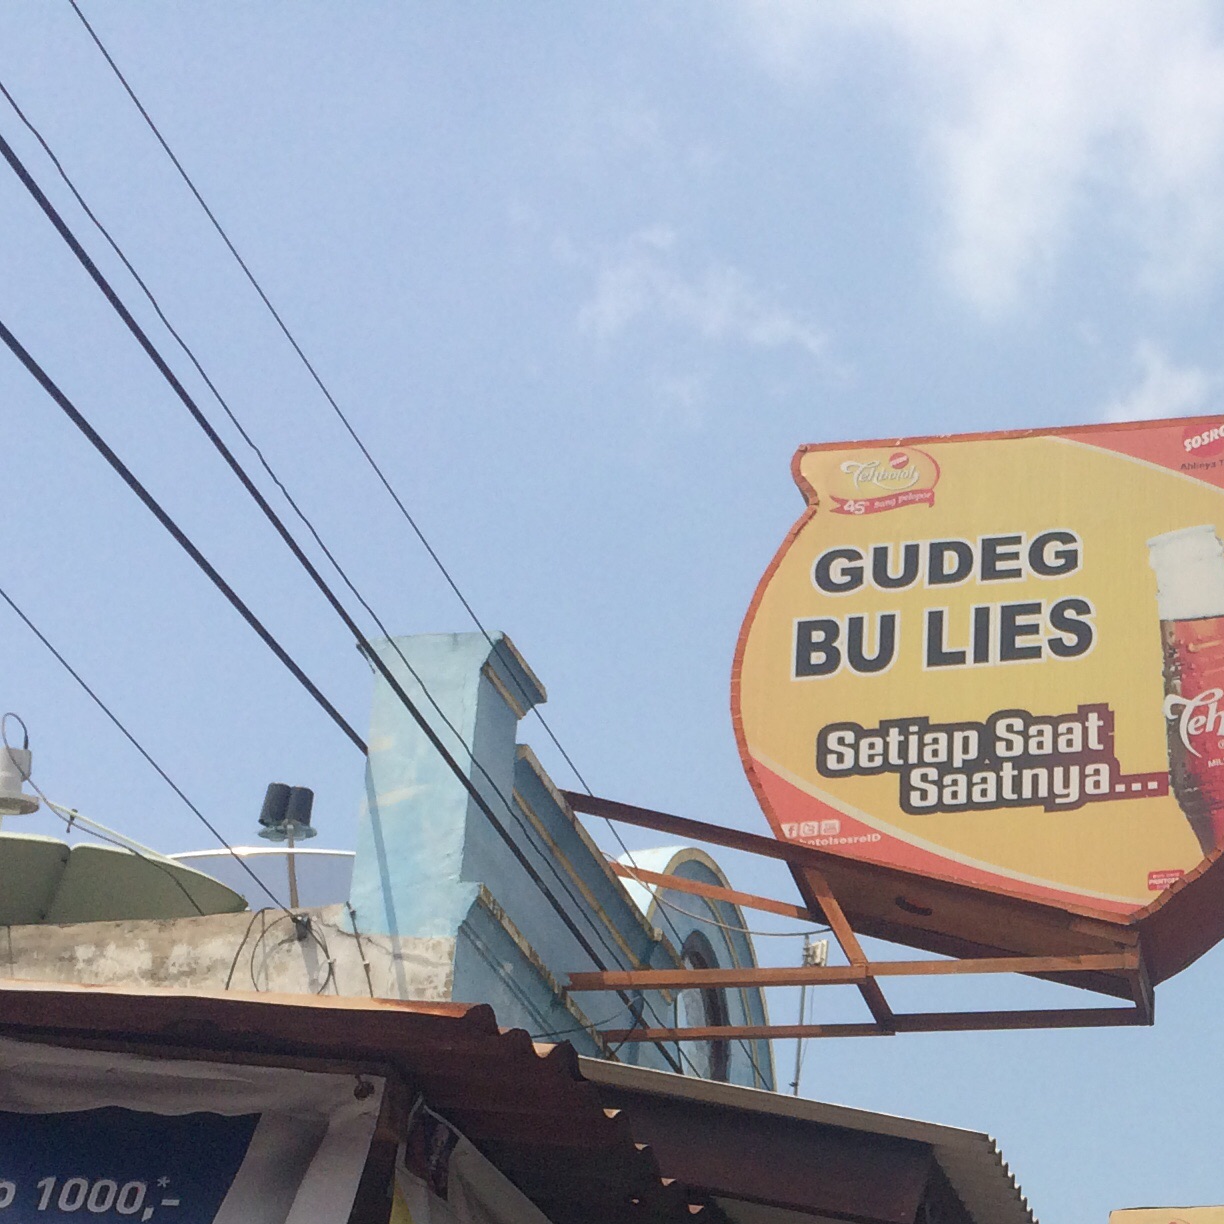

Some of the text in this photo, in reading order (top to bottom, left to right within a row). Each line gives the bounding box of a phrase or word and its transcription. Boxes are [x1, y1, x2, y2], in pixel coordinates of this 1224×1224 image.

[813, 531, 1080, 594] GUDEG
[794, 598, 1093, 680] BU LIES
[824, 711, 1105, 770] Setiap Saat
[909, 762, 1159, 809] Saatnya...
